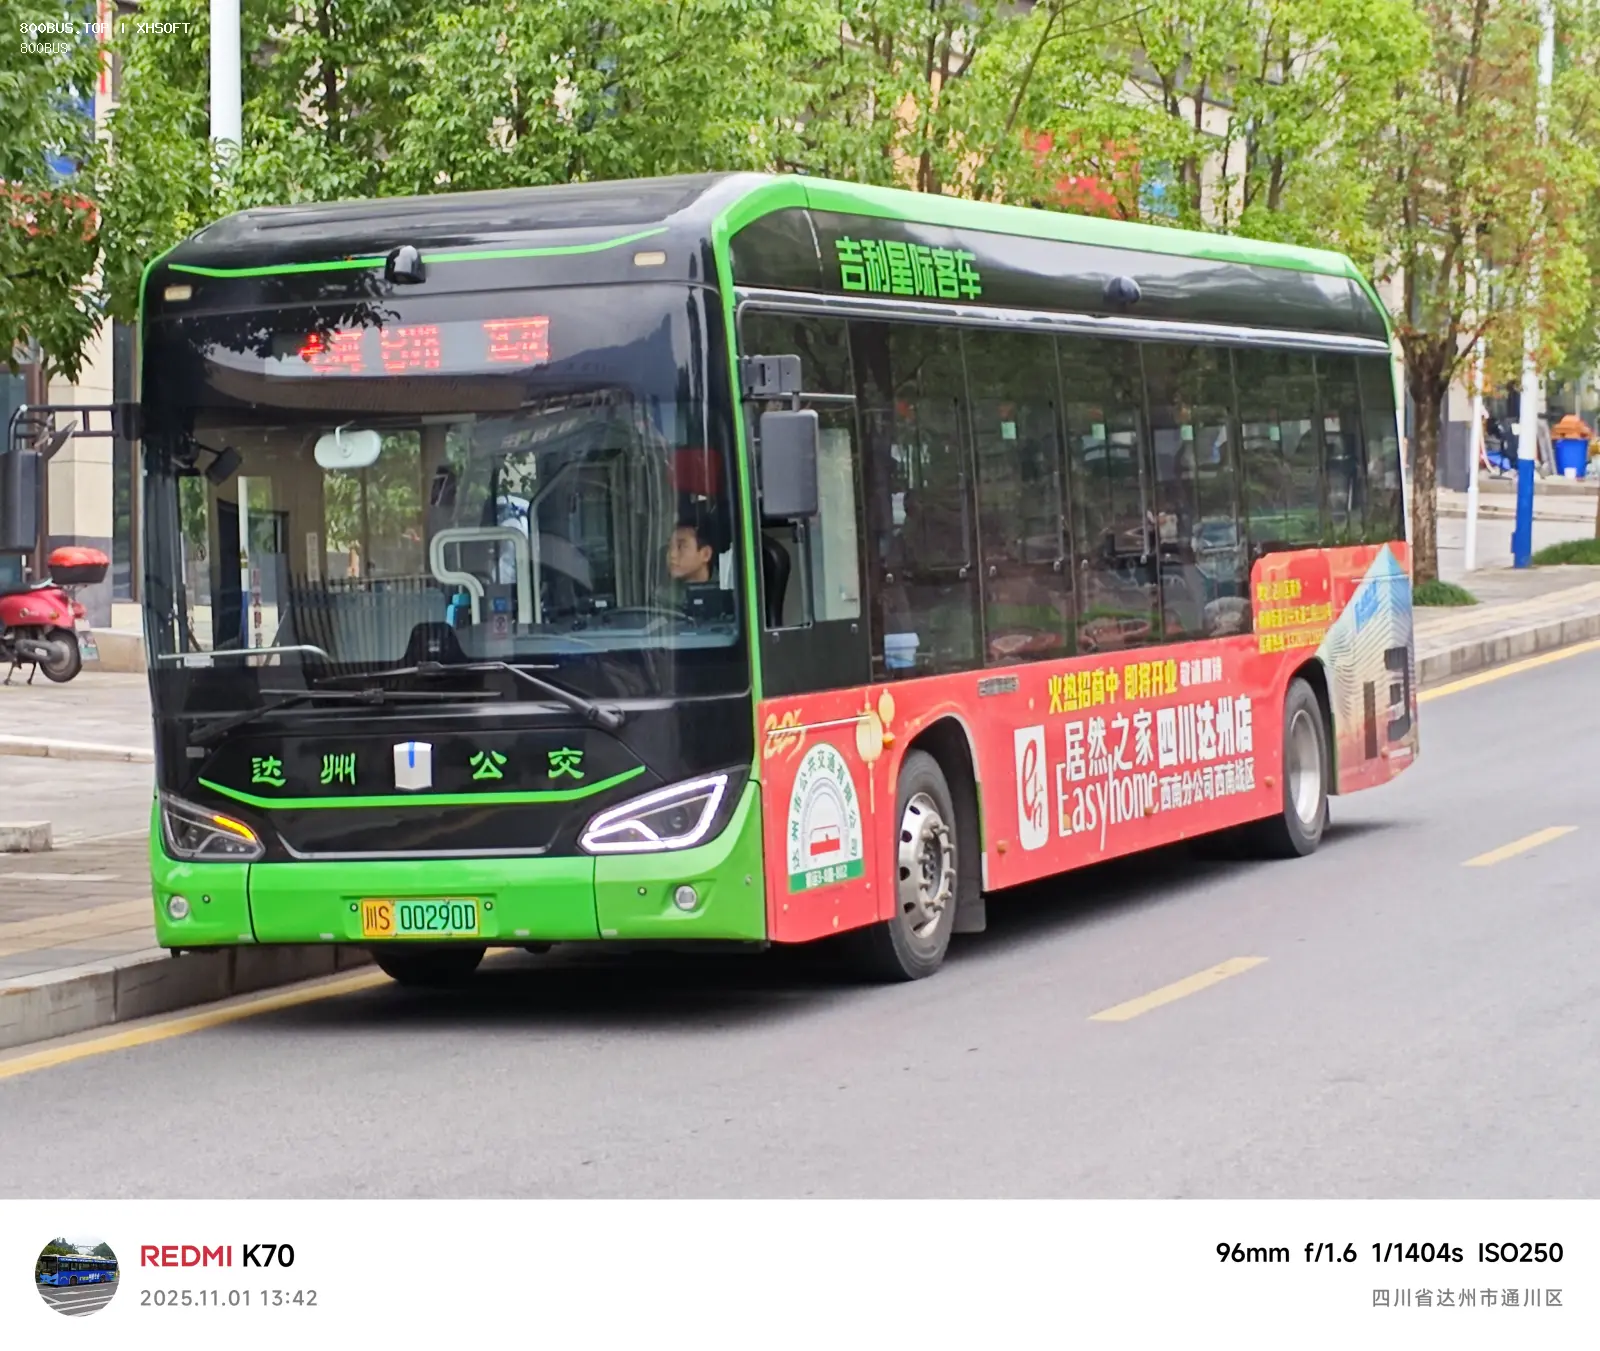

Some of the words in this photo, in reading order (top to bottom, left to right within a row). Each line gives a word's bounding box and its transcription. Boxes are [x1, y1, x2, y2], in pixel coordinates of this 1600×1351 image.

[835, 236, 982, 300] 吉利星际客车
[1049, 667, 1119, 714] 火热招商中
[1124, 658, 1178, 701] 即将开业
[251, 752, 356, 787] 达州
[469, 746, 585, 781] 公交
[1065, 708, 1153, 781] 居然之家
[1156, 693, 1253, 769] 四川达州店
[1056, 752, 1159, 851] Easyhome
[366, 905, 390, 930] 川S
[401, 904, 476, 930] 00290D
